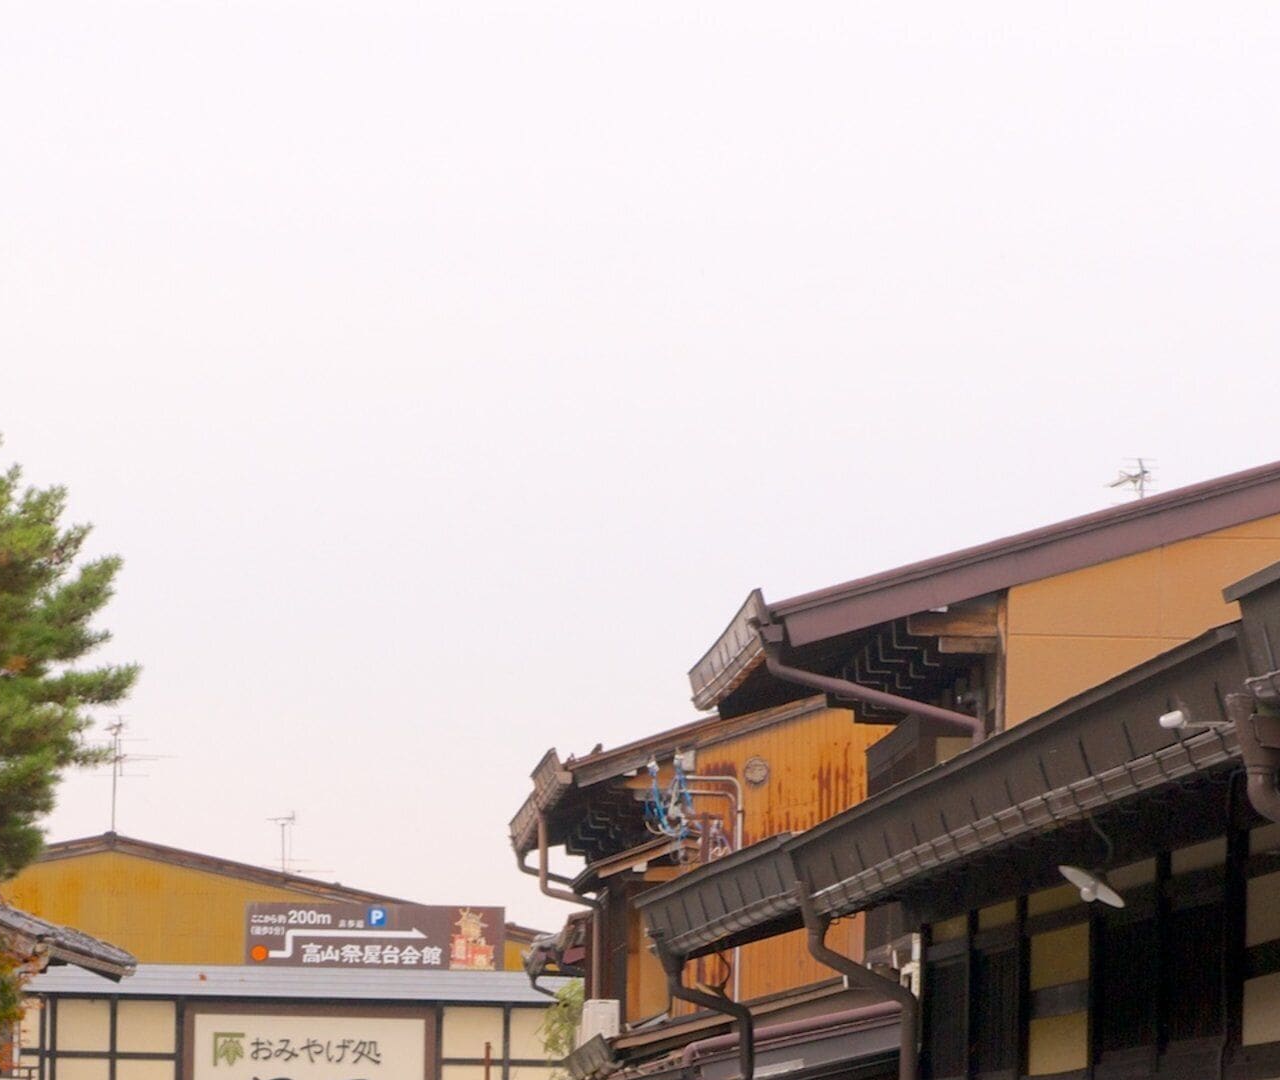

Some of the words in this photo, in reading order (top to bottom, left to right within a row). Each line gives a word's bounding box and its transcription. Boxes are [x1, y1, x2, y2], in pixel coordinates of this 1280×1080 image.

[287, 909, 332, 925] 200m
[301, 943, 443, 965] 高山祭屋台会館
[250, 1037, 382, 1065] おみやげ処
